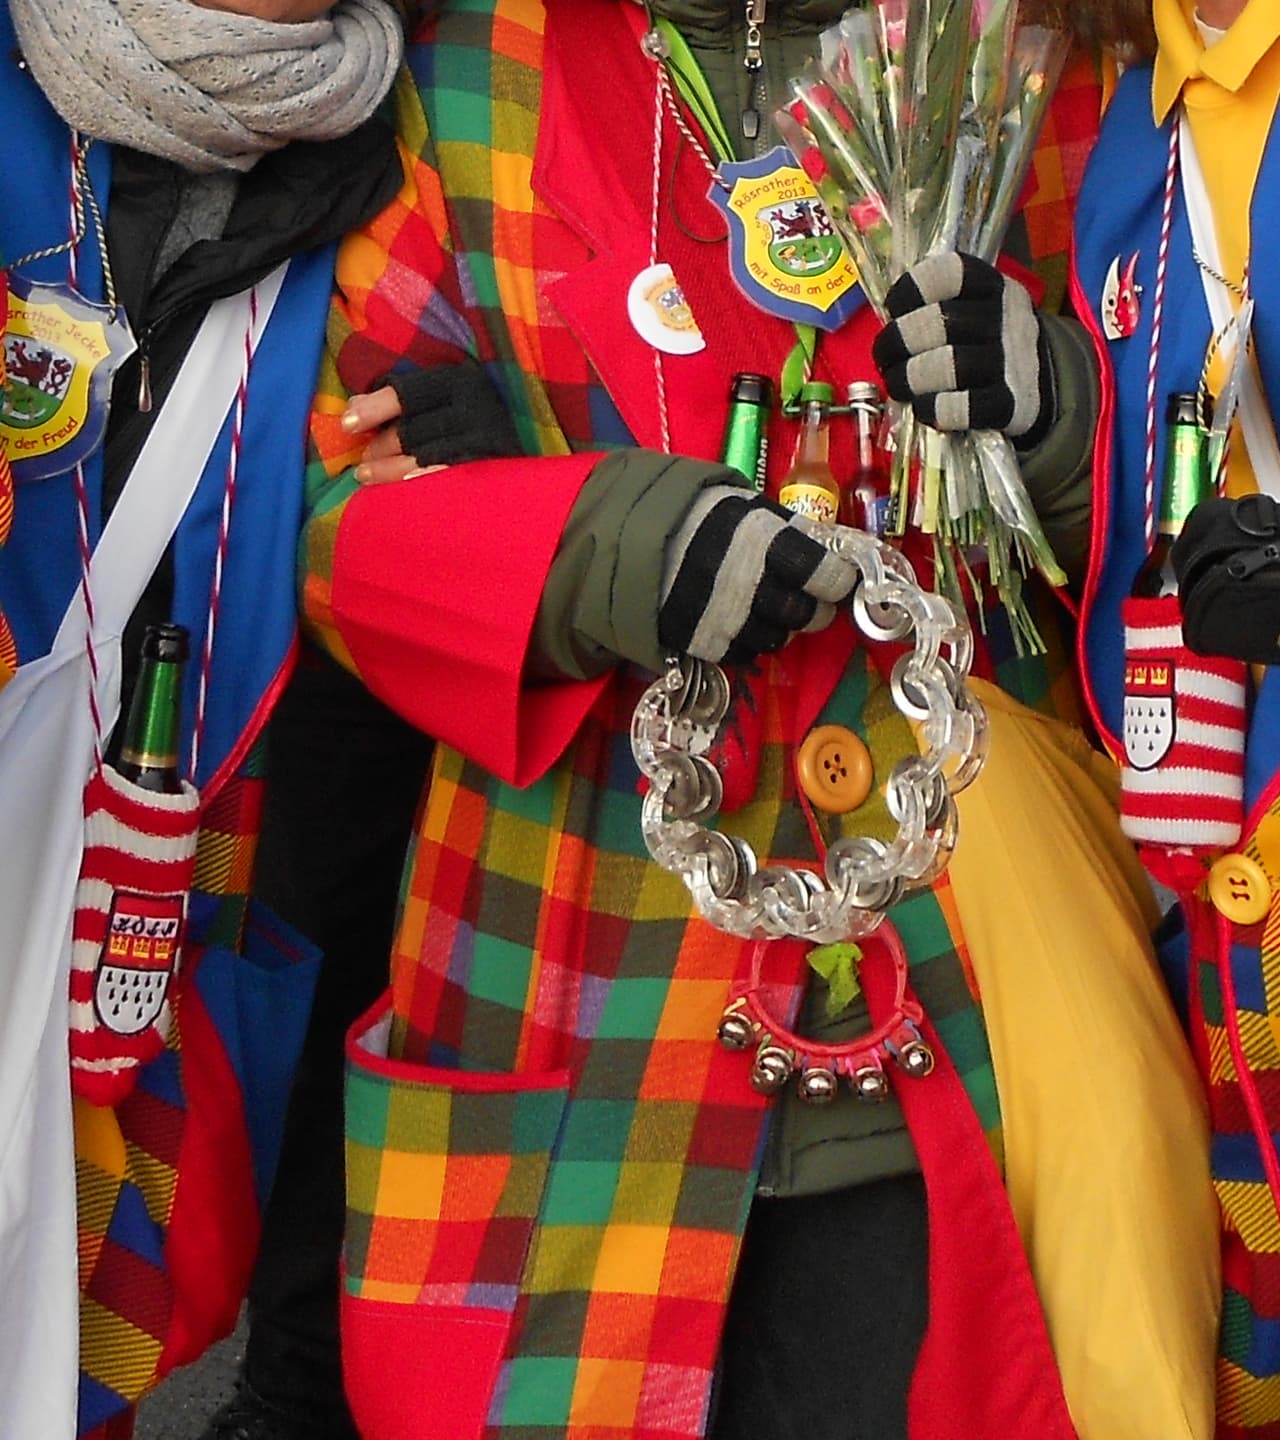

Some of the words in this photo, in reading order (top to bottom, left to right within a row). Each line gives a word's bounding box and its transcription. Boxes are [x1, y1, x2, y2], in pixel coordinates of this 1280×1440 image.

[777, 186, 807, 200] 2013
[750, 262, 768, 279] mit
[770, 278, 800, 295] Spaß
[807, 285, 821, 295] an
[825, 275, 845, 290] der
[7, 309, 62, 328] srather
[14, 436, 38, 450] der
[42, 415, 79, 447] Freud
